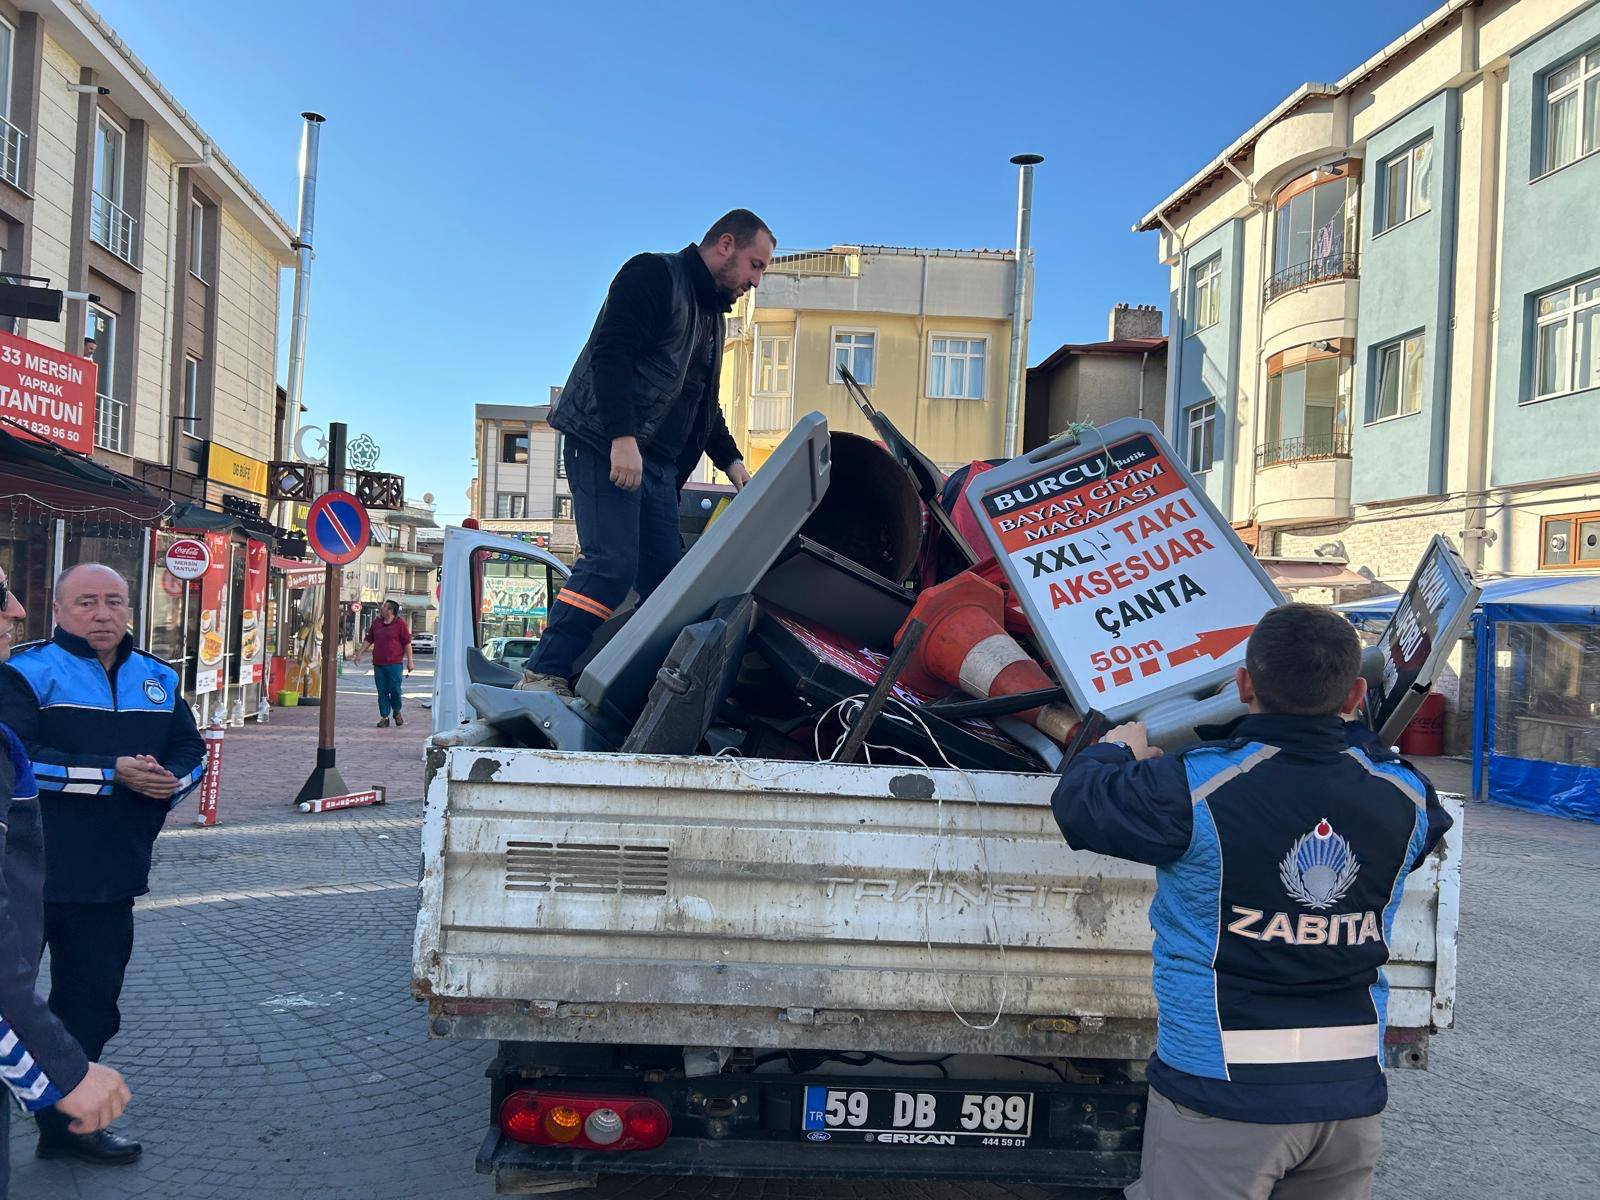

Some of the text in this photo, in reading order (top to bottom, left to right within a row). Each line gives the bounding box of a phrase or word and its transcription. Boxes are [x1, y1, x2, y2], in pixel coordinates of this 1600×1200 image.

[1, 345, 82, 384] 33 MERSİN
[18, 373, 63, 397] YAPRAK
[0, 384, 82, 426] TANTUNİ
[31, 422, 51, 436] 829
[52, 426, 65, 439] 96
[67, 431, 79, 442] 50
[993, 451, 1146, 511] BURCU Butik
[998, 462, 1166, 533] BAYAN GİYİM
[1023, 484, 1159, 542] MAĞAZASI
[1113, 497, 1198, 545] TAKI
[1048, 527, 1216, 610] AKSESUAR
[1418, 557, 1450, 614] BAYAN
[1094, 572, 1207, 639] ÇANTA
[1089, 638, 1165, 672] 50m
[815, 876, 1093, 910] TRANSIT
[1227, 904, 1381, 946] ZABITA
[808, 1090, 1026, 1131] TR 59 DB 589
[877, 1133, 956, 1145] ERKAN
[981, 1136, 1026, 1147] 444 59 01
